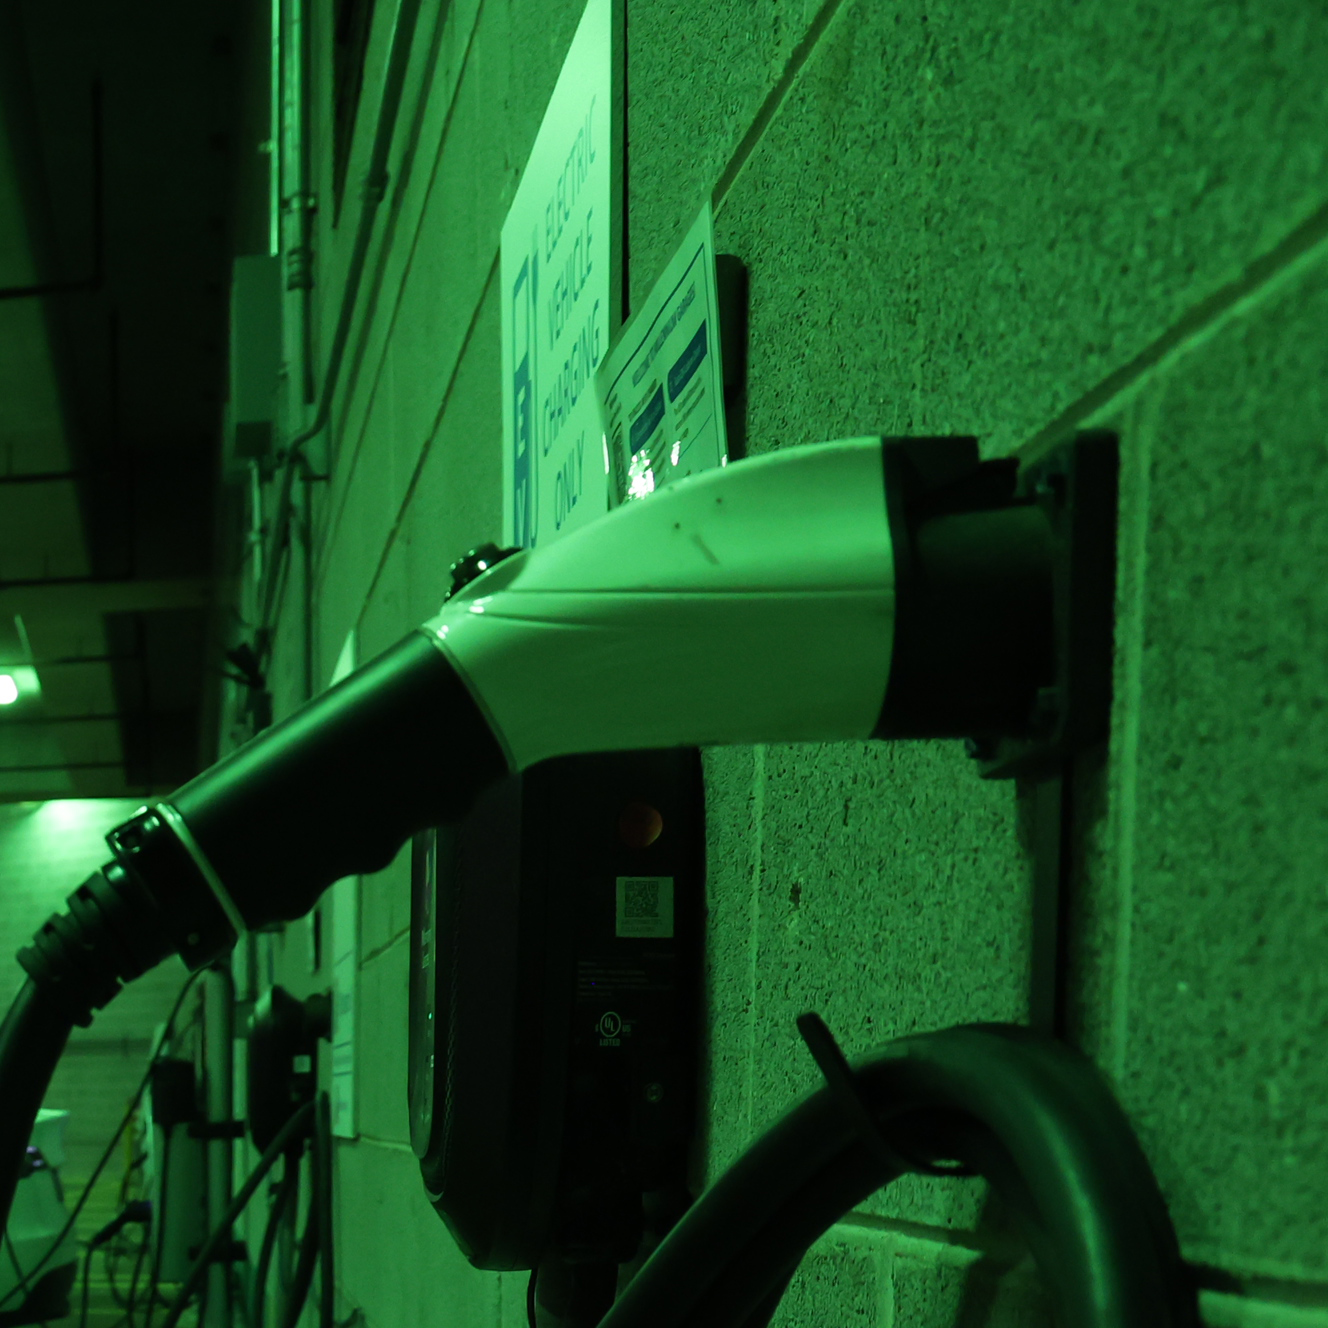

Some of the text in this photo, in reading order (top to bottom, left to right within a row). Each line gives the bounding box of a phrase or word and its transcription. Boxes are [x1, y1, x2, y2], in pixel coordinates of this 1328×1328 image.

[546, 94, 596, 263] ELECTRIC
[548, 207, 592, 350] VEHICLE
[544, 298, 599, 457] CHARGING
[556, 430, 584, 530] ONLY
[599, 1038, 621, 1047] LISTED
